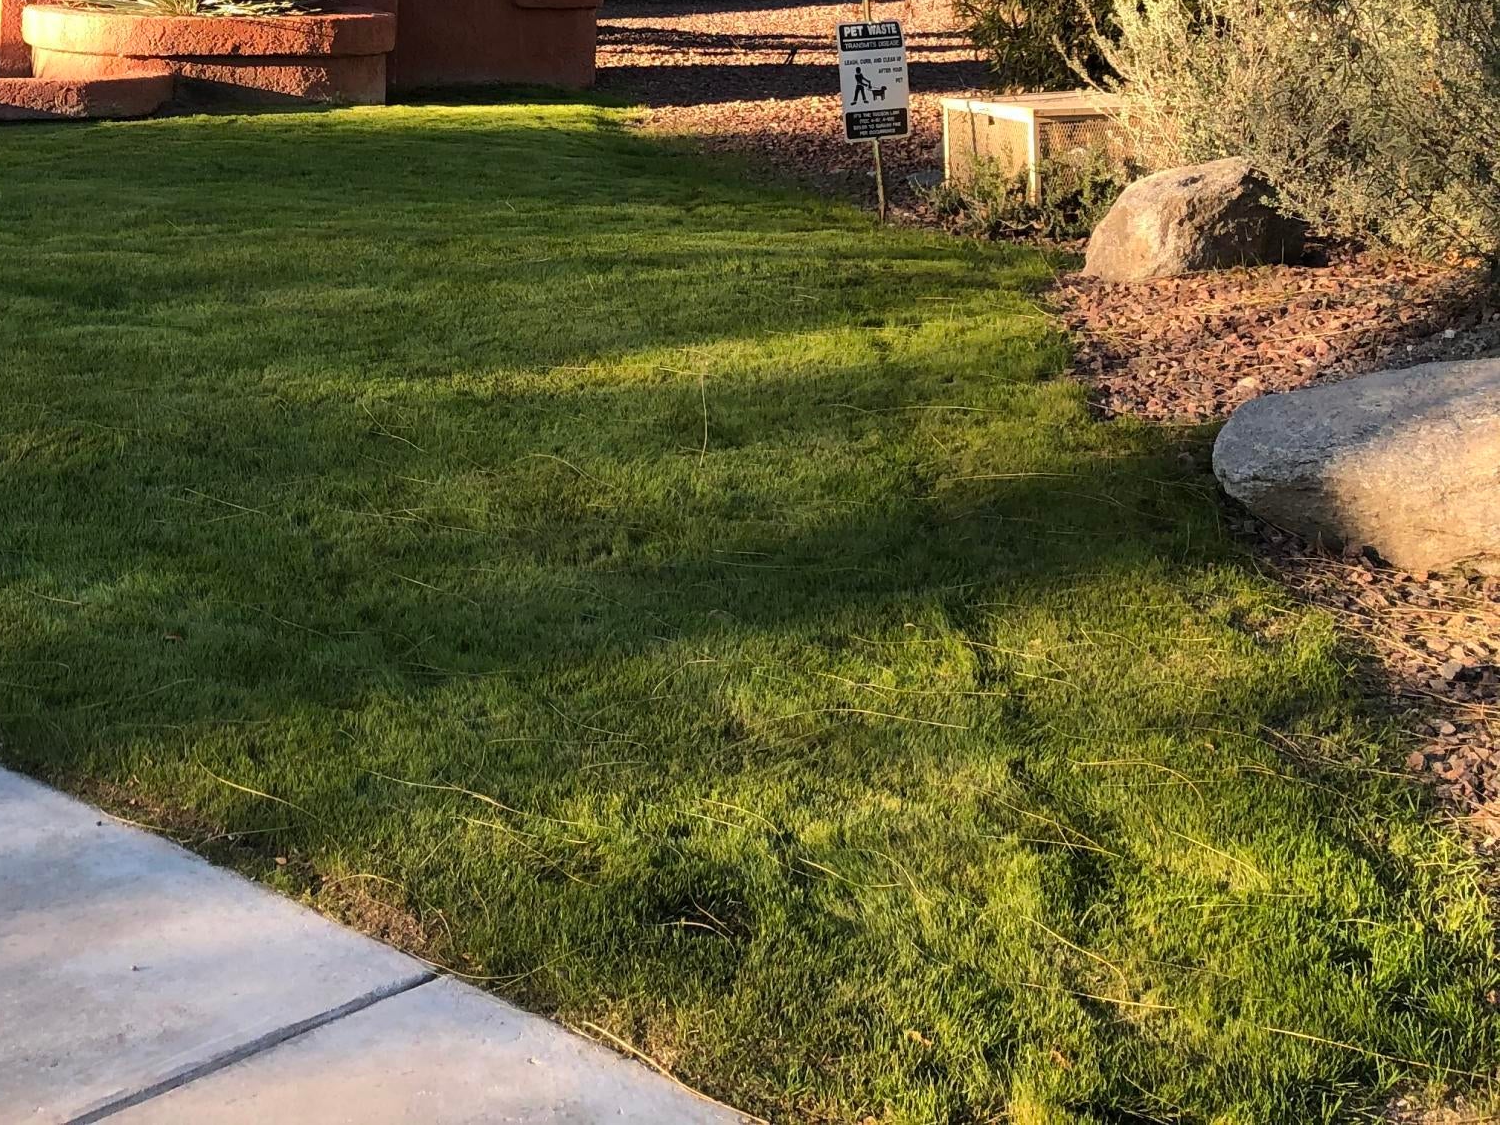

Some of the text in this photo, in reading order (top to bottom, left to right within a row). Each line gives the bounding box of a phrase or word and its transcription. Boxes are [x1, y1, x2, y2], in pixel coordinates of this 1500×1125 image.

[843, 23, 897, 37] PET WASTE
[844, 39, 900, 49] TRANSMITS DISEASE
